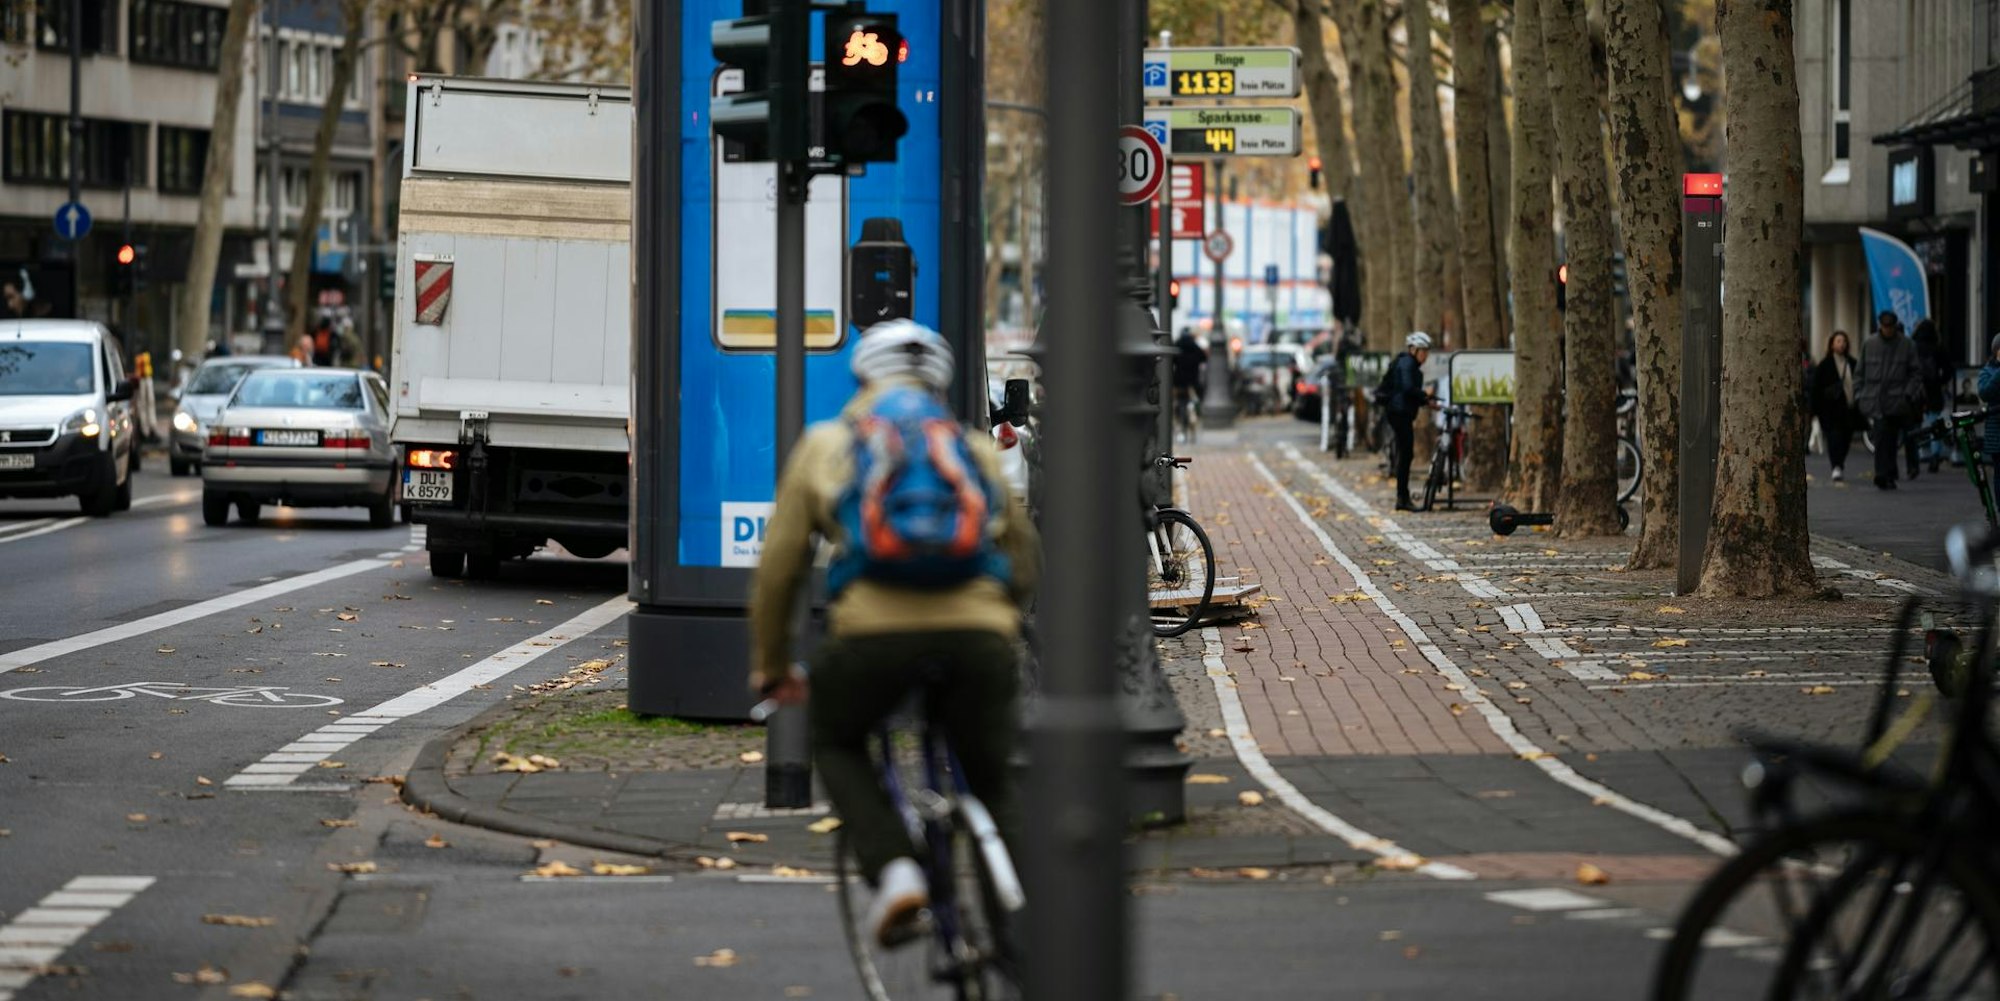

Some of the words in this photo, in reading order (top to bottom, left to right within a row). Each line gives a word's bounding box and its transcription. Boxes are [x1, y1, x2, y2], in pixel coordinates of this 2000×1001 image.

[1214, 53, 1245, 67] Ringe
[1178, 71, 1233, 94] 1133
[1198, 110, 1262, 125] Sparkasse
[1205, 129, 1234, 152] 44
[420, 472, 437, 485] DU
[407, 485, 415, 497] K
[418, 486, 450, 499] 8579
